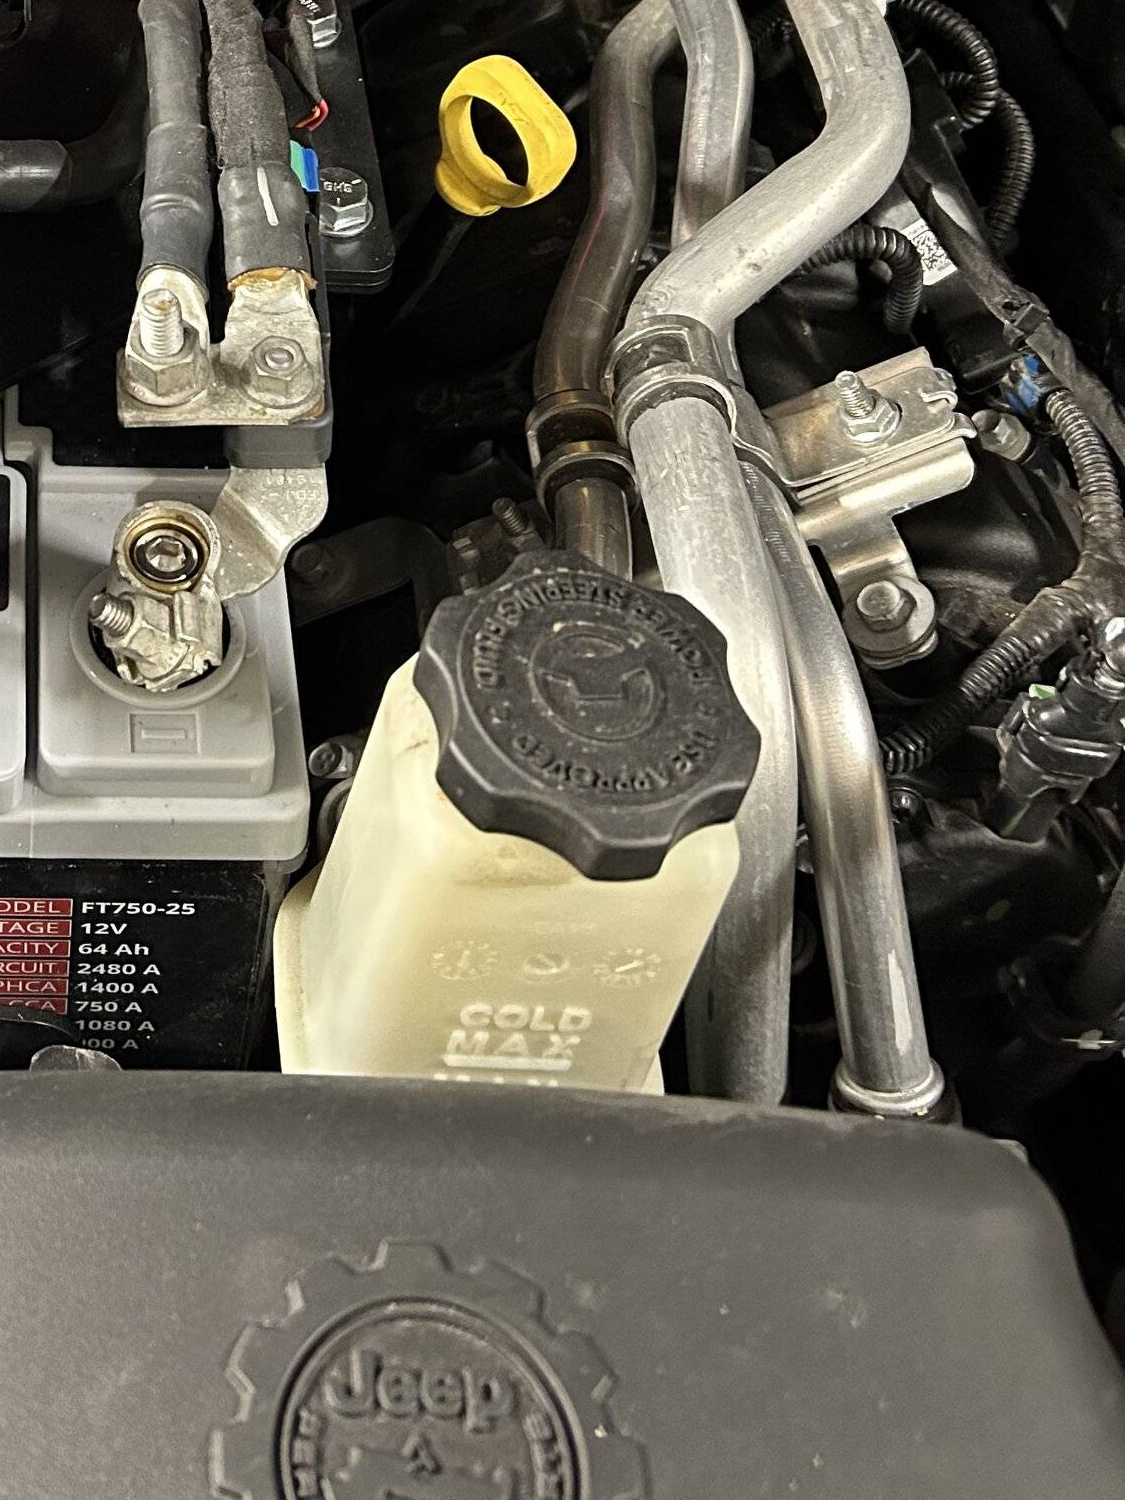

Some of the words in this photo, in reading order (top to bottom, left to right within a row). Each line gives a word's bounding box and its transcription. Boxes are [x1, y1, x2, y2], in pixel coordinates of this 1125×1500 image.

[498, 577, 629, 628] STEERING
[473, 615, 509, 692] FLUID
[513, 731, 669, 794] APPROVED
[81, 901, 196, 915] FT750-25
[80, 922, 127, 935] 12V
[78, 943, 108, 955] 64
[115, 943, 149, 956] Ah
[77, 963, 137, 975] 2480
[142, 964, 161, 975] A
[76, 982, 135, 994] 1400
[141, 983, 159, 994] A
[75, 1001, 119, 1012] 750
[125, 1002, 143, 1013] A
[76, 1019, 131, 1031] 1080
[137, 1021, 155, 1032] A
[82, 1038, 115, 1049] 00
[122, 1039, 140, 1049] A
[447, 1029, 581, 1060] MAX
[323, 1348, 520, 1434] Jeep
